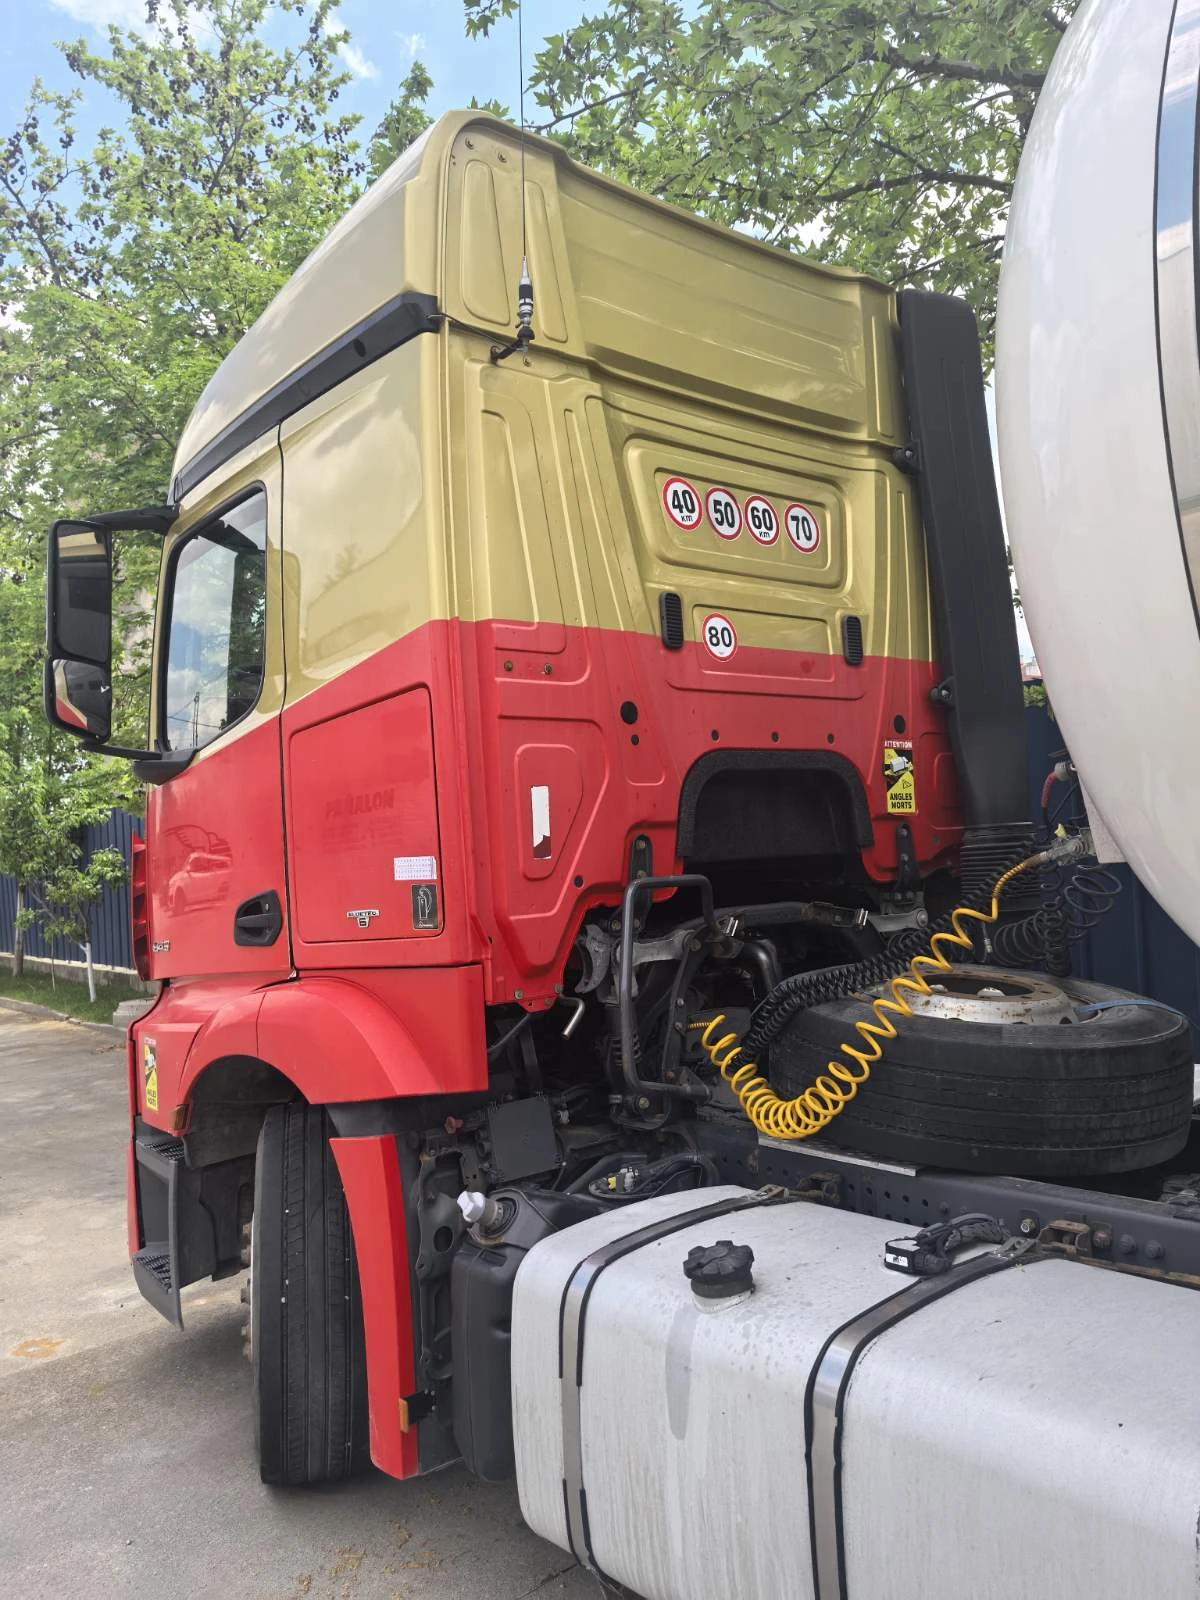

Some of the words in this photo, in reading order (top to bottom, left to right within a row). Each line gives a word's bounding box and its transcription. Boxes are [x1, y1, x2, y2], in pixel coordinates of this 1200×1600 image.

[671, 489, 696, 514] 40
[680, 514, 694, 523] km
[712, 499, 736, 529] 50
[750, 506, 774, 531] 60
[790, 515, 813, 542] 70
[707, 625, 733, 648] 80
[884, 740, 913, 749] ATTENTION
[890, 792, 913, 800] ANGLES
[891, 801, 912, 809] MORTS
